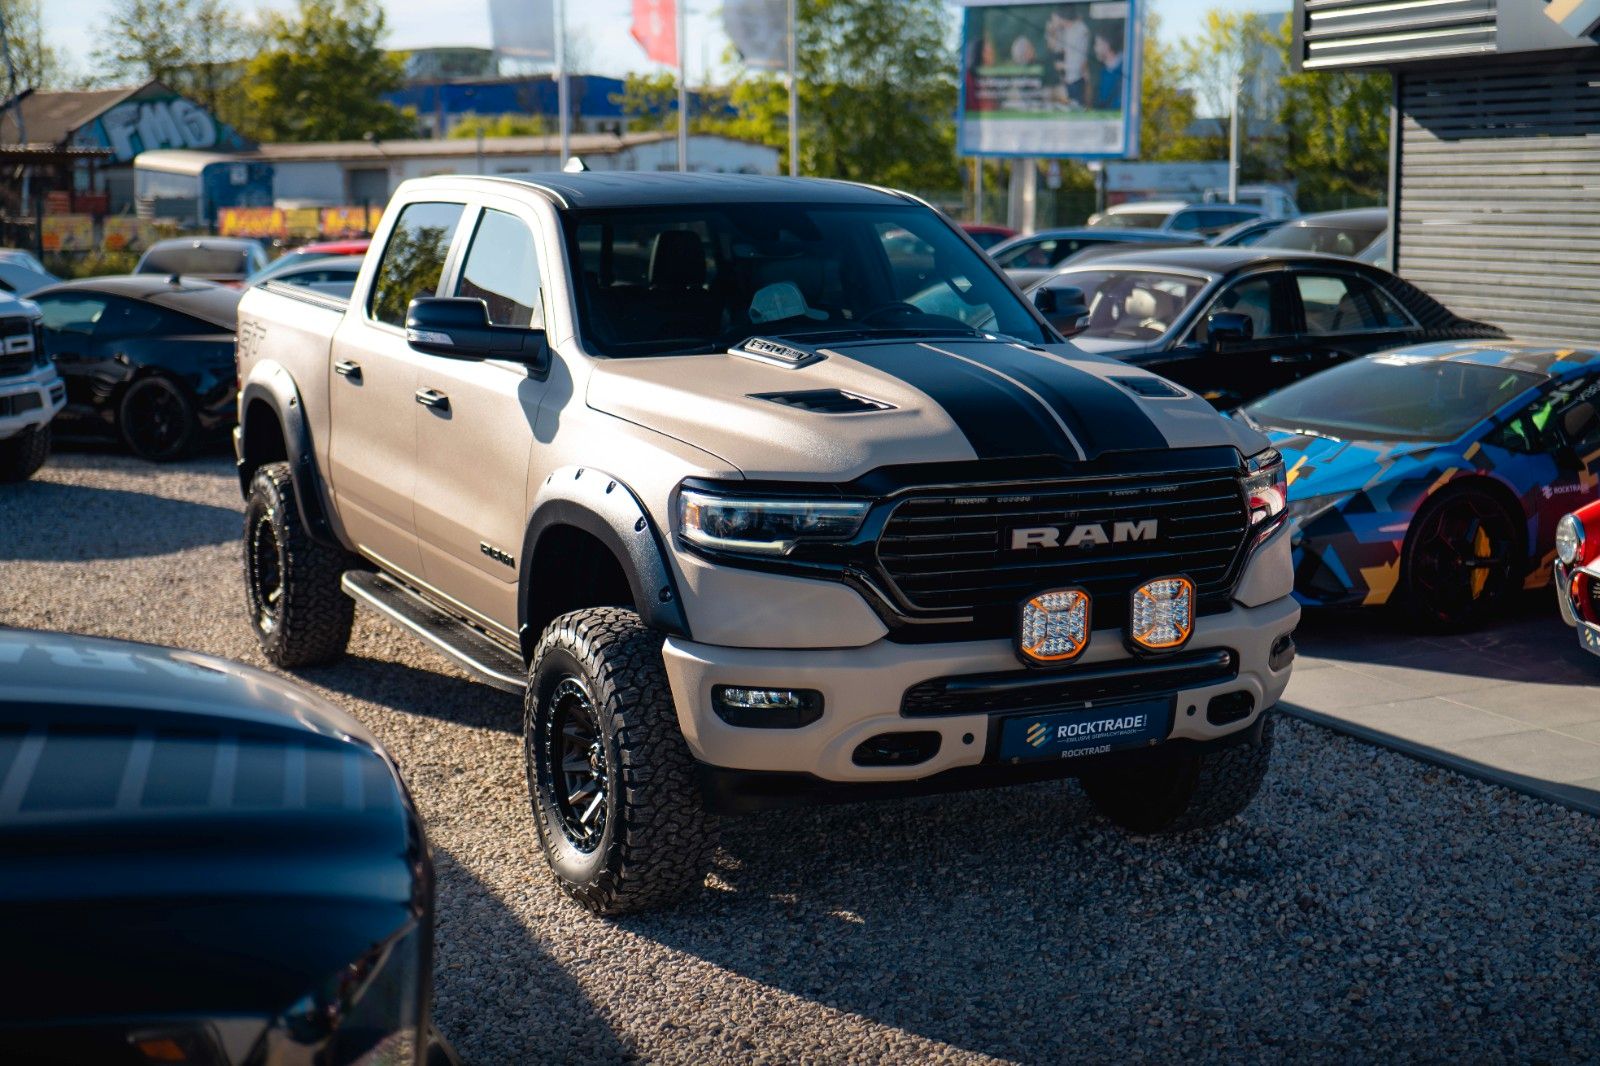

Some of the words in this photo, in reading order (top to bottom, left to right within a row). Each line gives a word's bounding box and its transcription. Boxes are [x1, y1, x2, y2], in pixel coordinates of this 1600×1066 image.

[1011, 519, 1159, 550] RAM
[1057, 715, 1144, 738] ROCKTRADE
[1061, 744, 1111, 757] ROCKTRADE
